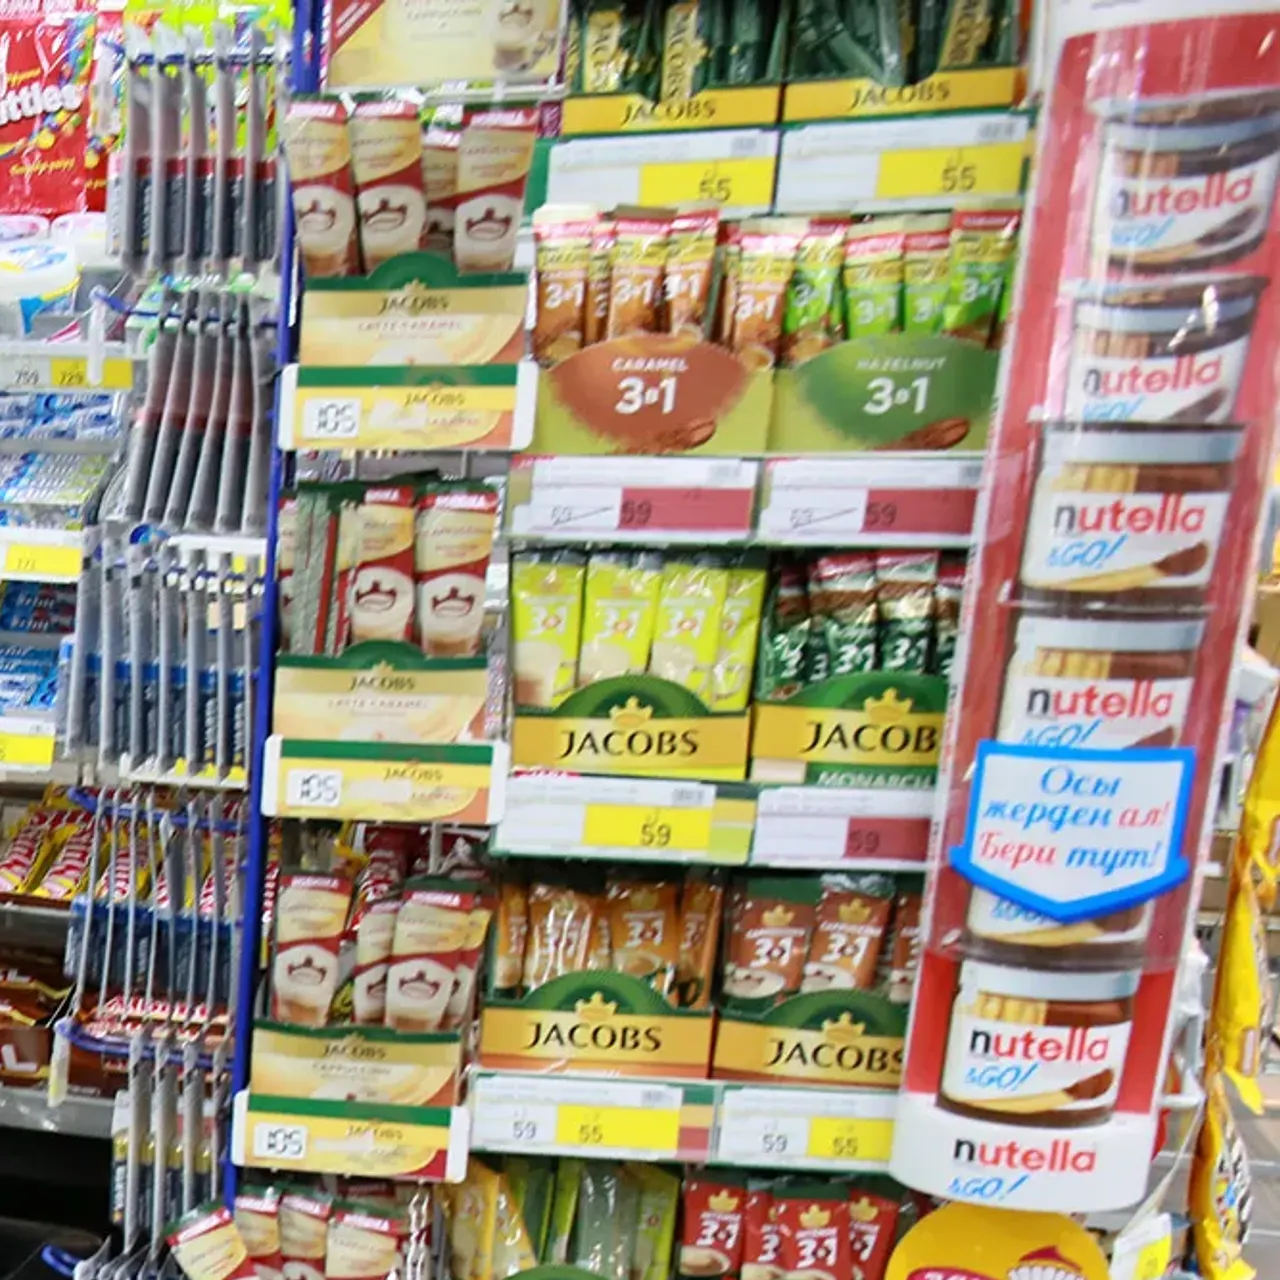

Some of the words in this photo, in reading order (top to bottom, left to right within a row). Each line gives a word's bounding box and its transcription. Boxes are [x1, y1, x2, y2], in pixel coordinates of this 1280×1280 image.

[620, 101, 717, 126] JACOBS
[699, 177, 731, 202] 55
[941, 166, 977, 193] 55
[1111, 167, 1256, 222] nutella
[612, 357, 689, 374] CARAMEL
[855, 356, 947, 373] HAZELNUT
[1081, 354, 1223, 396] nutella
[620, 503, 651, 526] 59
[865, 503, 896, 526] 59
[1052, 491, 1206, 538] nutella
[1025, 679, 1175, 720] nutella
[557, 729, 700, 760] JACOBS
[800, 721, 937, 754] JACOB
[1040, 764, 1123, 797] Осы
[981, 799, 1112, 838] жерден
[1116, 801, 1170, 831] ал!
[640, 824, 671, 848] 59
[848, 825, 881, 851] 59
[978, 831, 1056, 867] Бери
[1064, 838, 1163, 877] тут!
[523, 1021, 662, 1052] JACOBS
[969, 1025, 1110, 1064] nutella
[512, 1123, 537, 1141] 59
[578, 1124, 604, 1144] 55
[762, 1135, 789, 1154] 59
[832, 1137, 858, 1157] 55
[953, 1135, 1096, 1173] nutella
